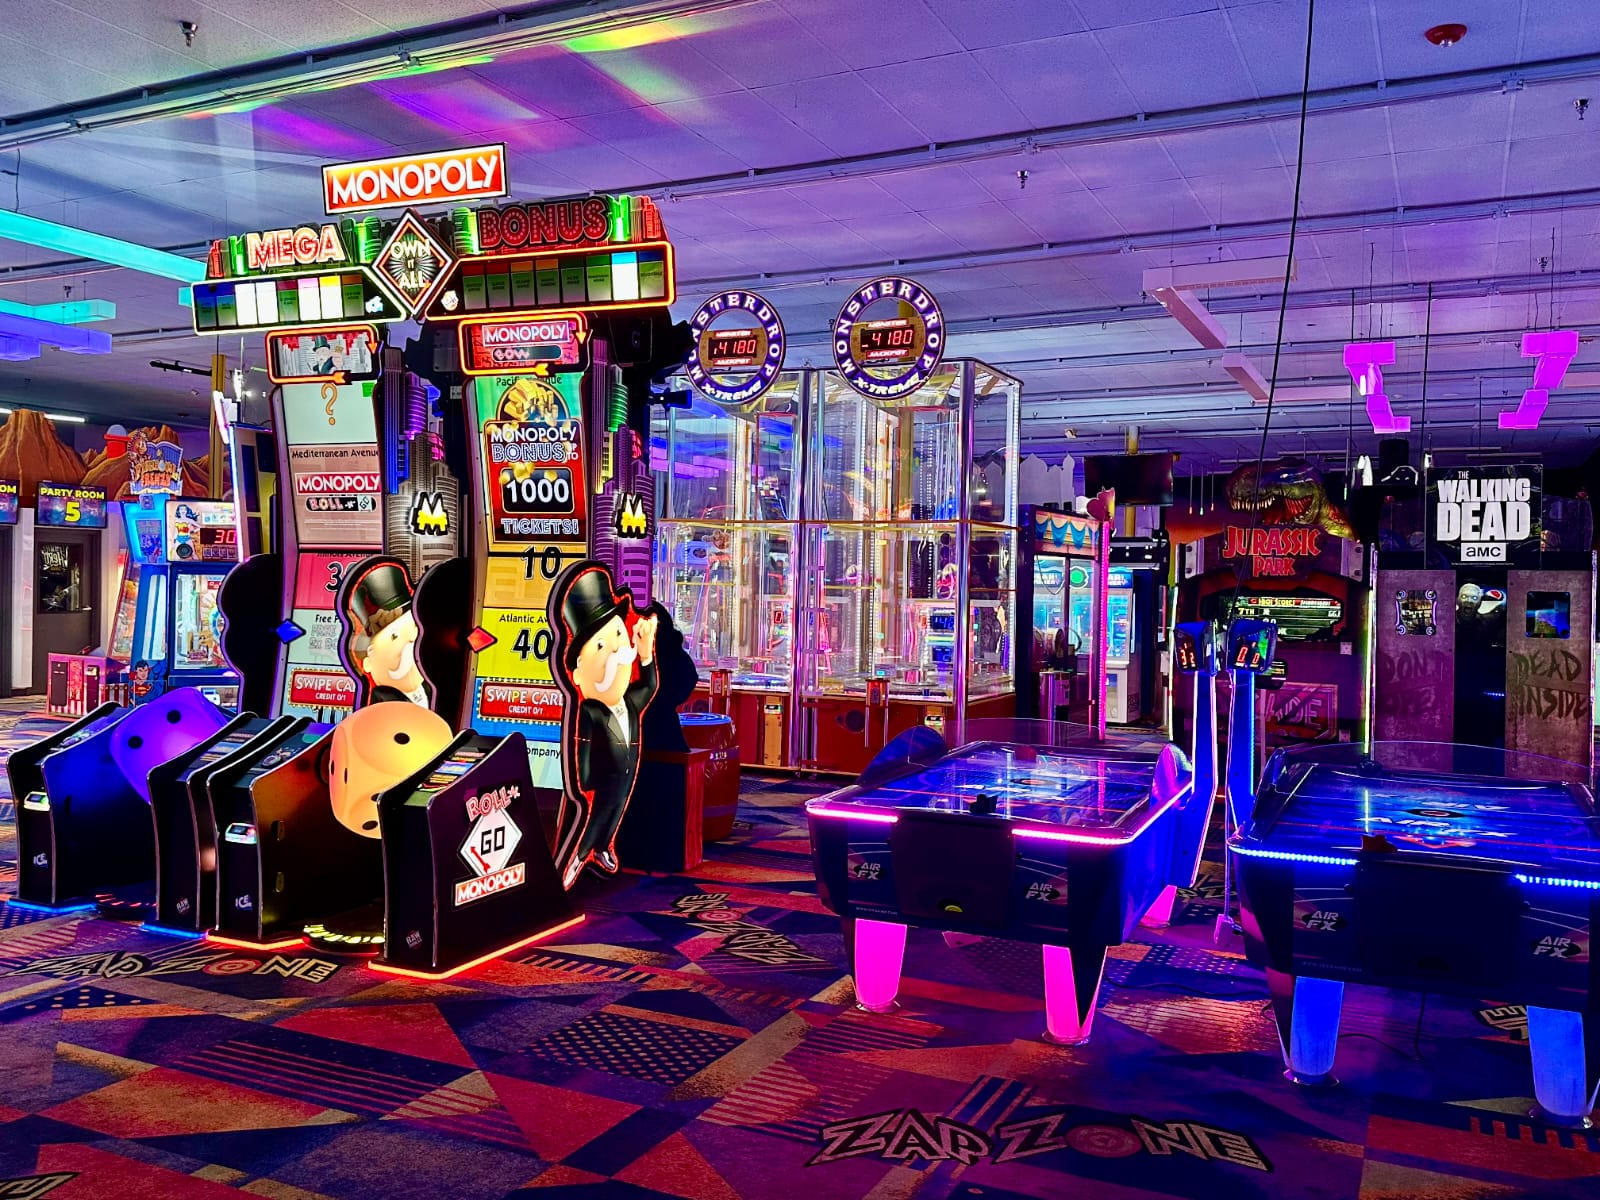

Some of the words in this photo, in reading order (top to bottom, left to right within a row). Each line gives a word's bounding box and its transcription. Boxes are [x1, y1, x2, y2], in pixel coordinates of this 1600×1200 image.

[331, 154, 498, 205] MONOPOLY
[478, 199, 609, 250] BONUS
[246, 224, 343, 269] MEGA
[390, 239, 431, 259] OWN
[400, 270, 428, 289] ALL
[485, 324, 567, 342] MONOPOLY
[868, 350, 908, 358] JACKPOT
[490, 427, 577, 442] MONOPOLY
[292, 449, 349, 459] Mediterranean
[491, 442, 566, 463] BONUS
[1458, 470, 1470, 480] THE
[0, 485, 17, 494] OM
[299, 475, 380, 491] MONOPOLY
[506, 478, 570, 503] 1000
[1437, 478, 1531, 502] WALKING
[40, 487, 73, 497] PARTY
[76, 490, 105, 500] ROOM
[64, 501, 81, 522] 5
[308, 498, 344, 511] ROLL
[501, 518, 580, 535] TICKETS!
[1437, 501, 1531, 541] DEAD
[214, 529, 236, 544] 30
[1222, 525, 1321, 558] JURASSIC
[521, 546, 563, 580] 10
[1252, 555, 1295, 577] PARK
[315, 614, 332, 624] Free
[499, 614, 535, 624] Atlantic
[511, 629, 552, 661] 40
[1512, 651, 1582, 682] DEAD
[296, 676, 332, 692] SWIPE
[336, 678, 356, 693] CA
[315, 692, 336, 701] CREDIT
[487, 688, 528, 703] SWIPE
[1515, 686, 1589, 720] INSIDE
[508, 705, 532, 714] CREDIT
[526, 747, 561, 759] ompany
[465, 785, 512, 822] ROLL
[480, 826, 506, 856] GO
[33, 853, 48, 866] ICE
[861, 862, 881, 871] AIR
[857, 870, 880, 881] FX
[457, 867, 524, 903] MONOPOLY
[1029, 882, 1053, 892] AIR
[235, 895, 252, 909] ICE
[1025, 891, 1050, 902] FX
[1311, 911, 1339, 921] AIR
[1305, 920, 1337, 932] FX
[1538, 936, 1571, 947] AIR
[1533, 946, 1569, 959] FX
[806, 1108, 992, 1167] ZAP
[993, 1112, 1273, 1173] ZONE
